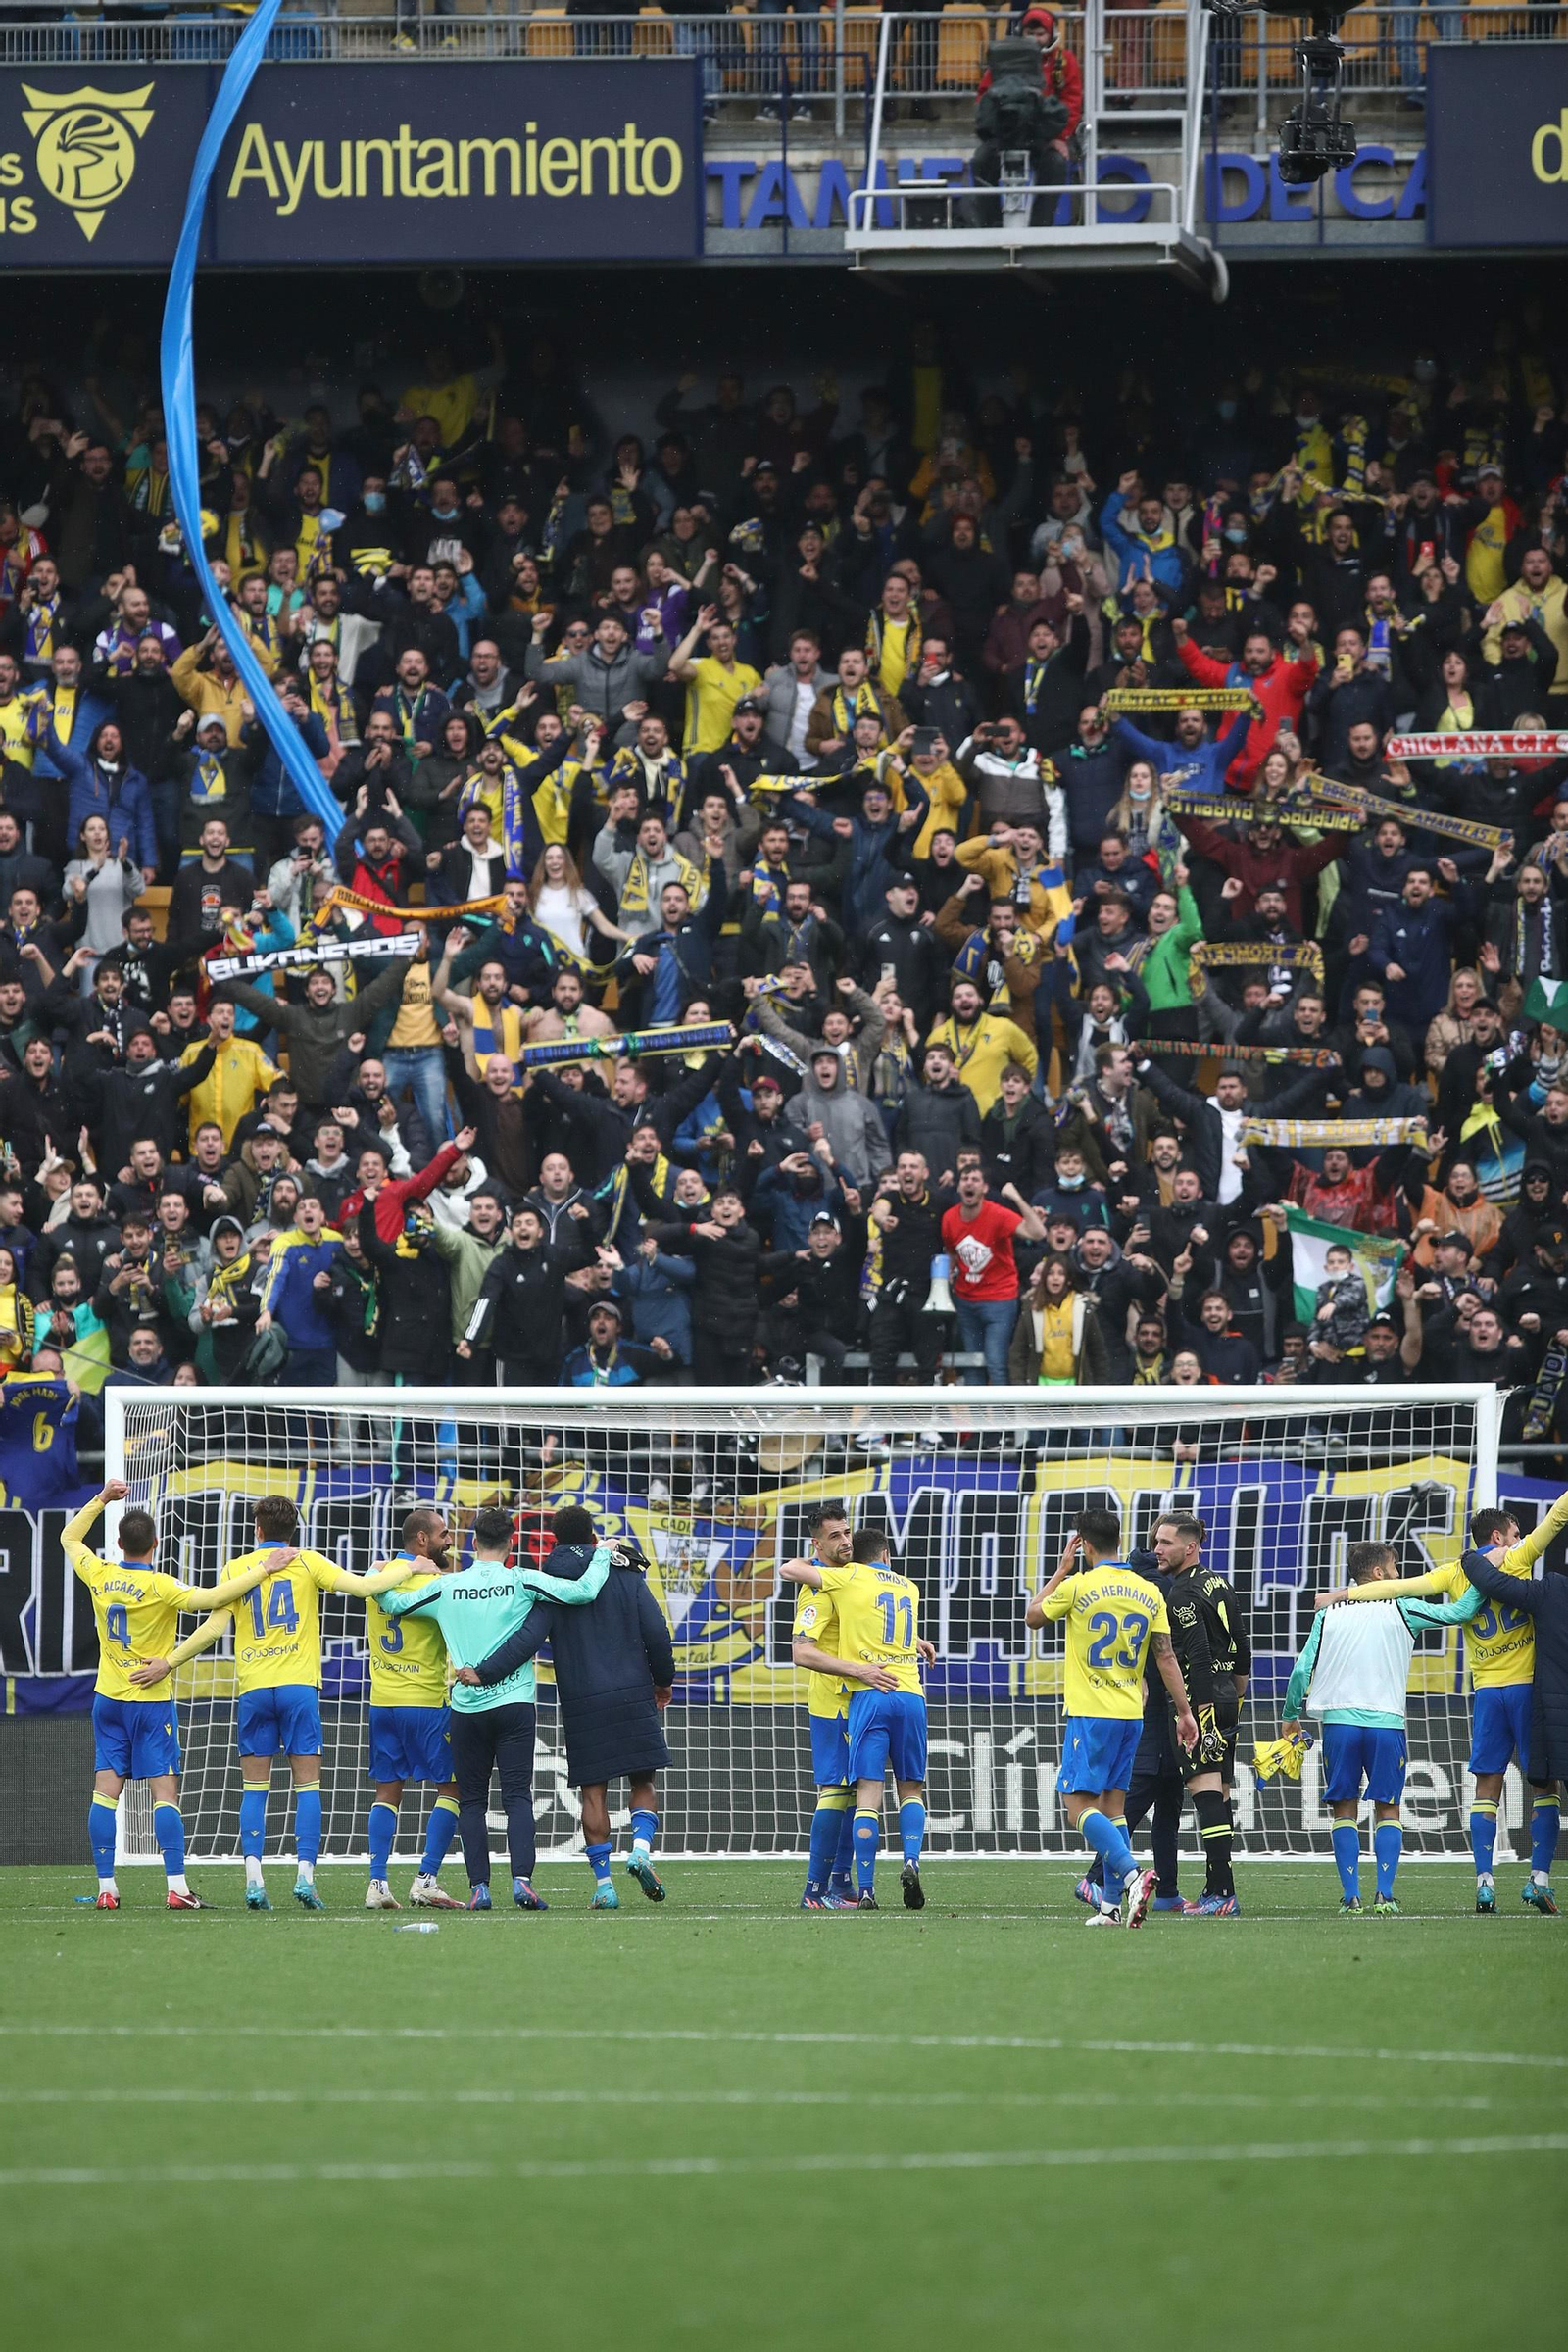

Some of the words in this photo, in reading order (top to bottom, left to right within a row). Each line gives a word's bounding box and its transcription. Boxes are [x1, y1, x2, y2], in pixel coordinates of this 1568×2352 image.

[227, 122, 683, 215] Ayuntamiento
[1204, 151, 1313, 222] DE
[1387, 735, 1505, 758] CHICLANA
[1512, 733, 1555, 753] C.F.
[33, 1411, 54, 1453] 6
[104, 1580, 147, 1603] ALCARAZ
[453, 1583, 514, 1601] macron
[875, 1572, 909, 1590] IDRISSI
[241, 1578, 300, 1641] 14
[875, 1591, 913, 1650] 11
[1074, 1591, 1101, 1615] LUIS
[106, 1602, 133, 1652] 4
[1087, 1611, 1150, 1671] 23
[1488, 1634, 1535, 1657] JOBCHAIN
